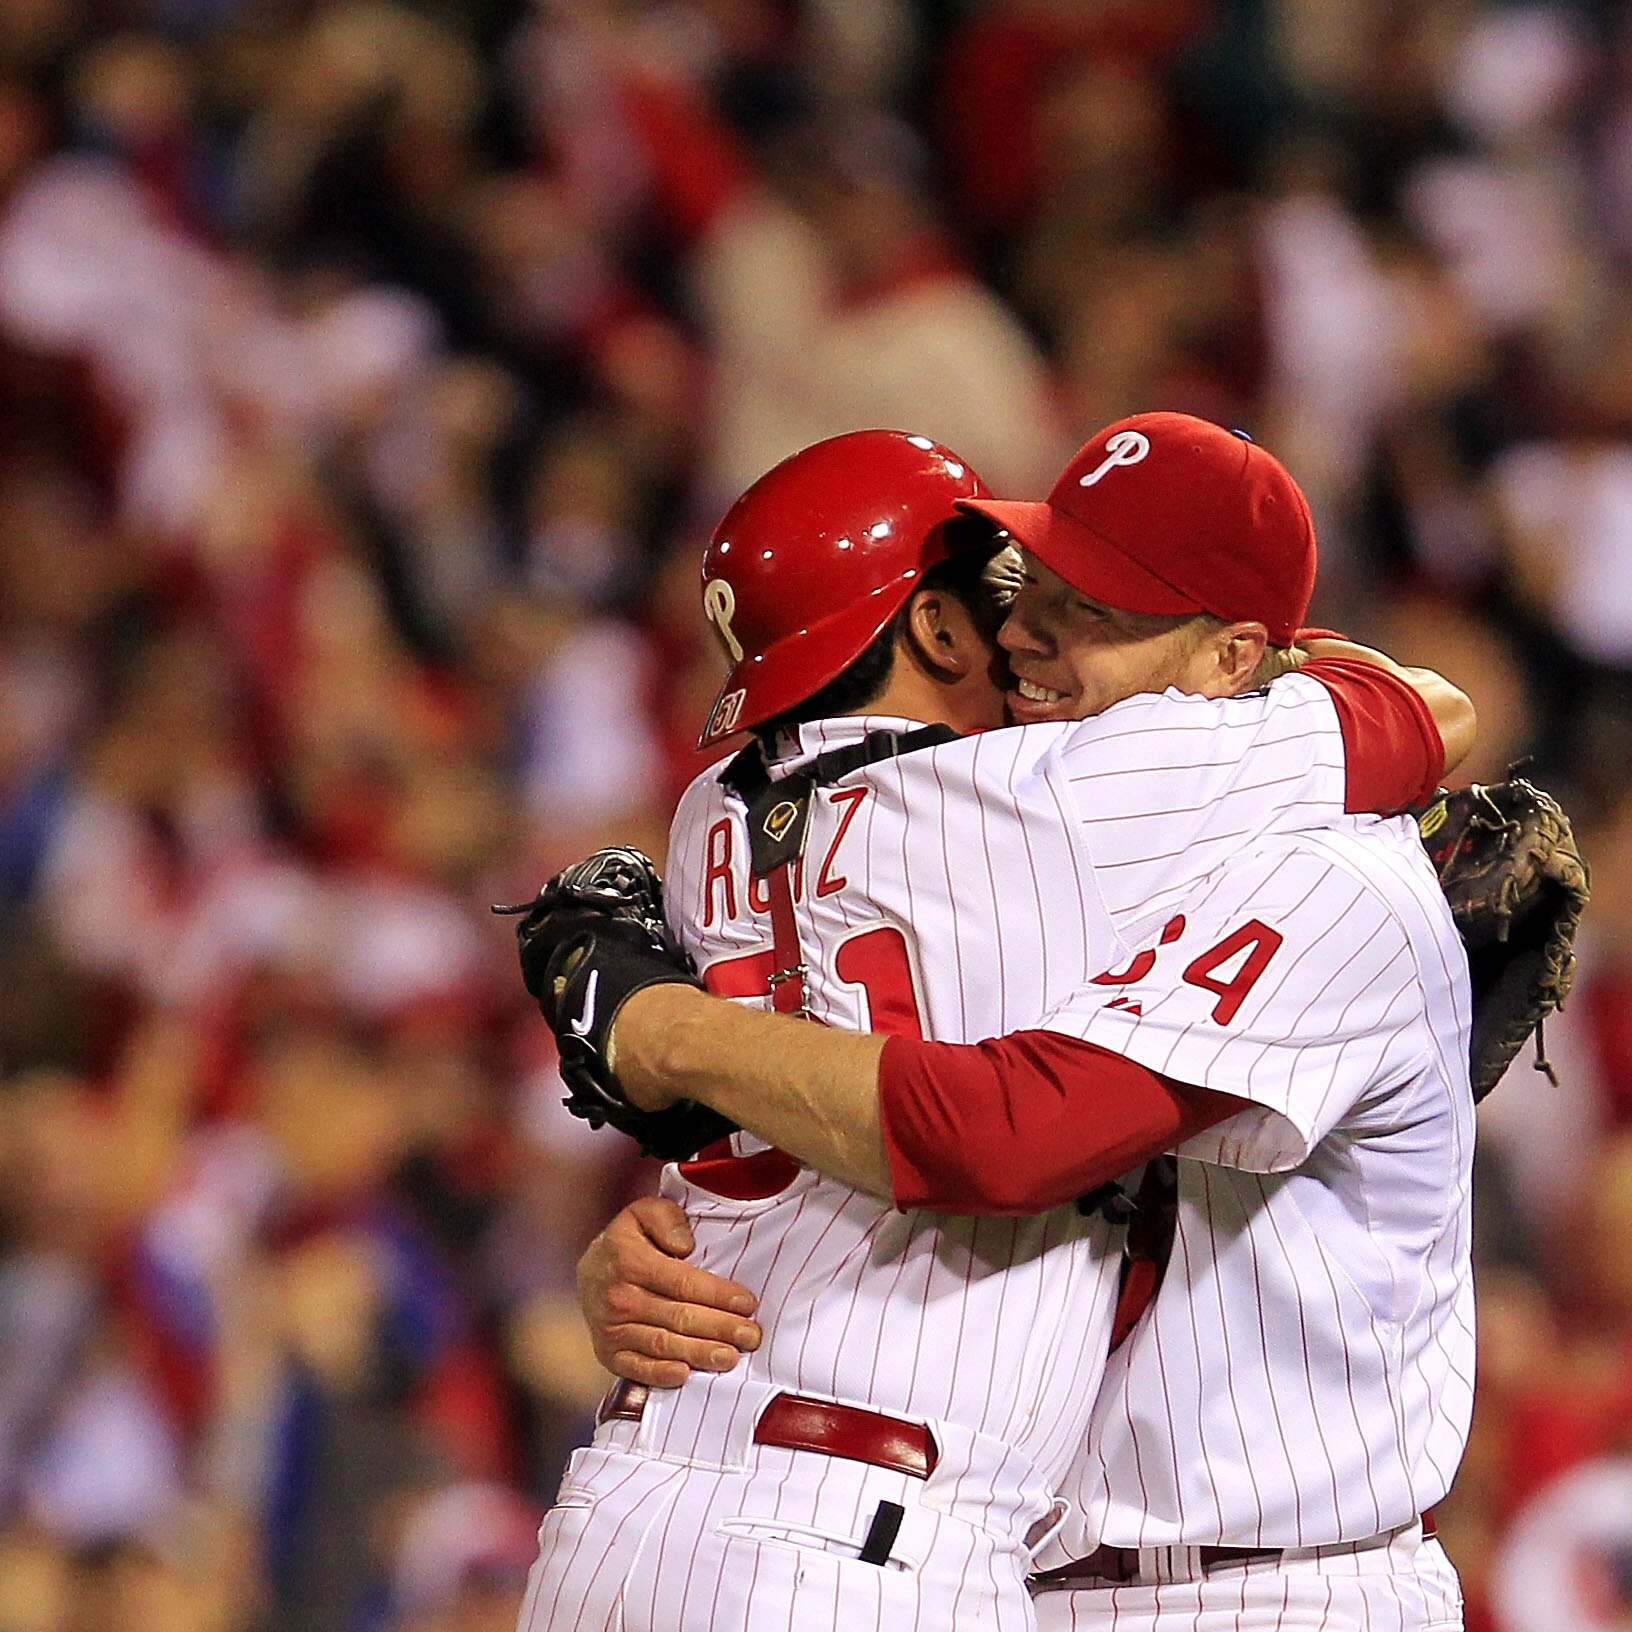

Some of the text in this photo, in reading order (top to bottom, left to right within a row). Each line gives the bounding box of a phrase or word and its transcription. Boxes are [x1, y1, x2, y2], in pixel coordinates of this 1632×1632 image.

[1079, 430, 1150, 487] P
[704, 578, 744, 662] P
[710, 688, 747, 737] 51
